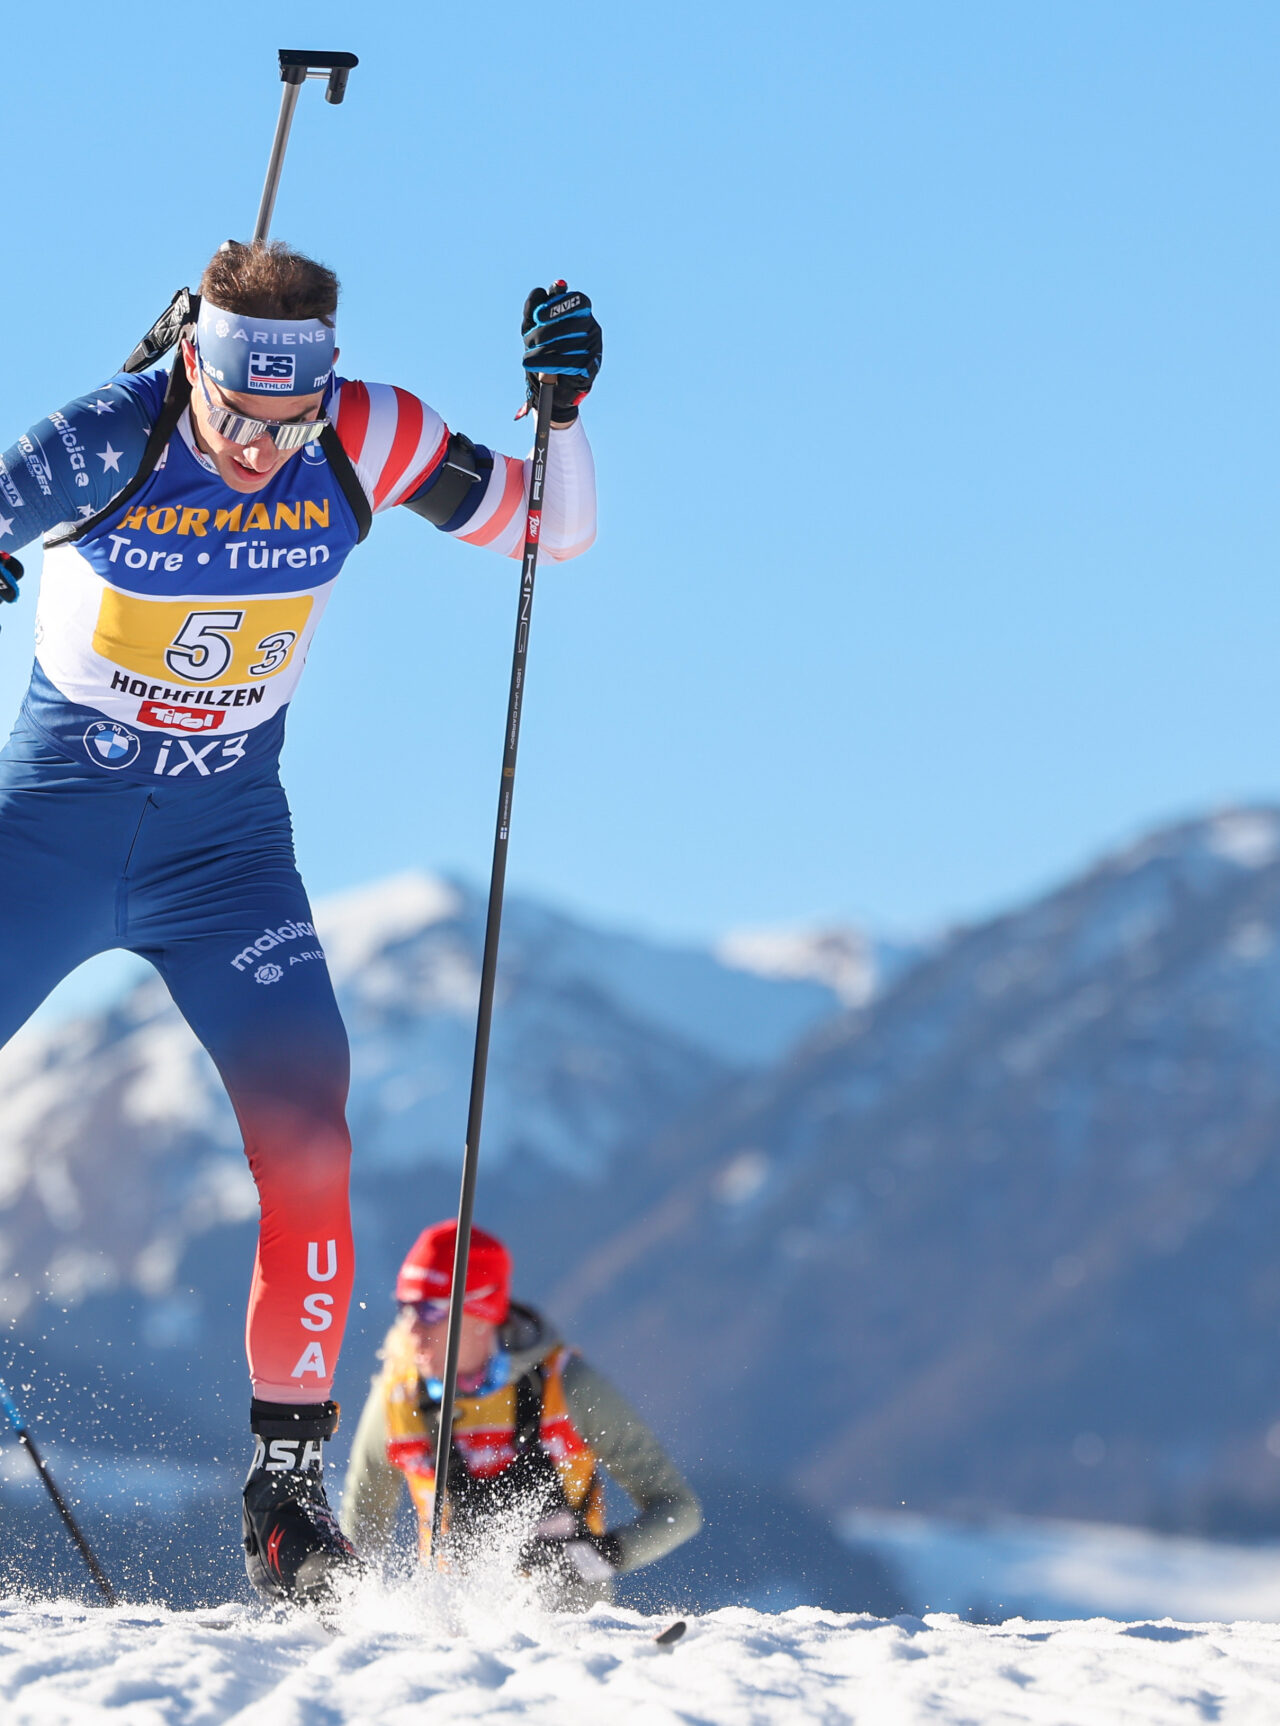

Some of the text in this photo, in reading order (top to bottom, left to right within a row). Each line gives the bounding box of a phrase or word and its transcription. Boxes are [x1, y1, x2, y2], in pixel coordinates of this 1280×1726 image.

[232, 328, 326, 345] ARIENS
[251, 353, 294, 378] US
[249, 381, 293, 390] BIATHLON
[28, 454, 52, 496] EDER
[532, 447, 545, 501] REX
[116, 498, 330, 537] HÖRMANN
[107, 534, 330, 572] Tore Türen
[164, 610, 298, 683] 5 3
[110, 671, 266, 707] HOCHFILZEN
[150, 706, 215, 729] Tirol
[153, 733, 249, 776] iX3
[290, 1239, 338, 1378] USA
